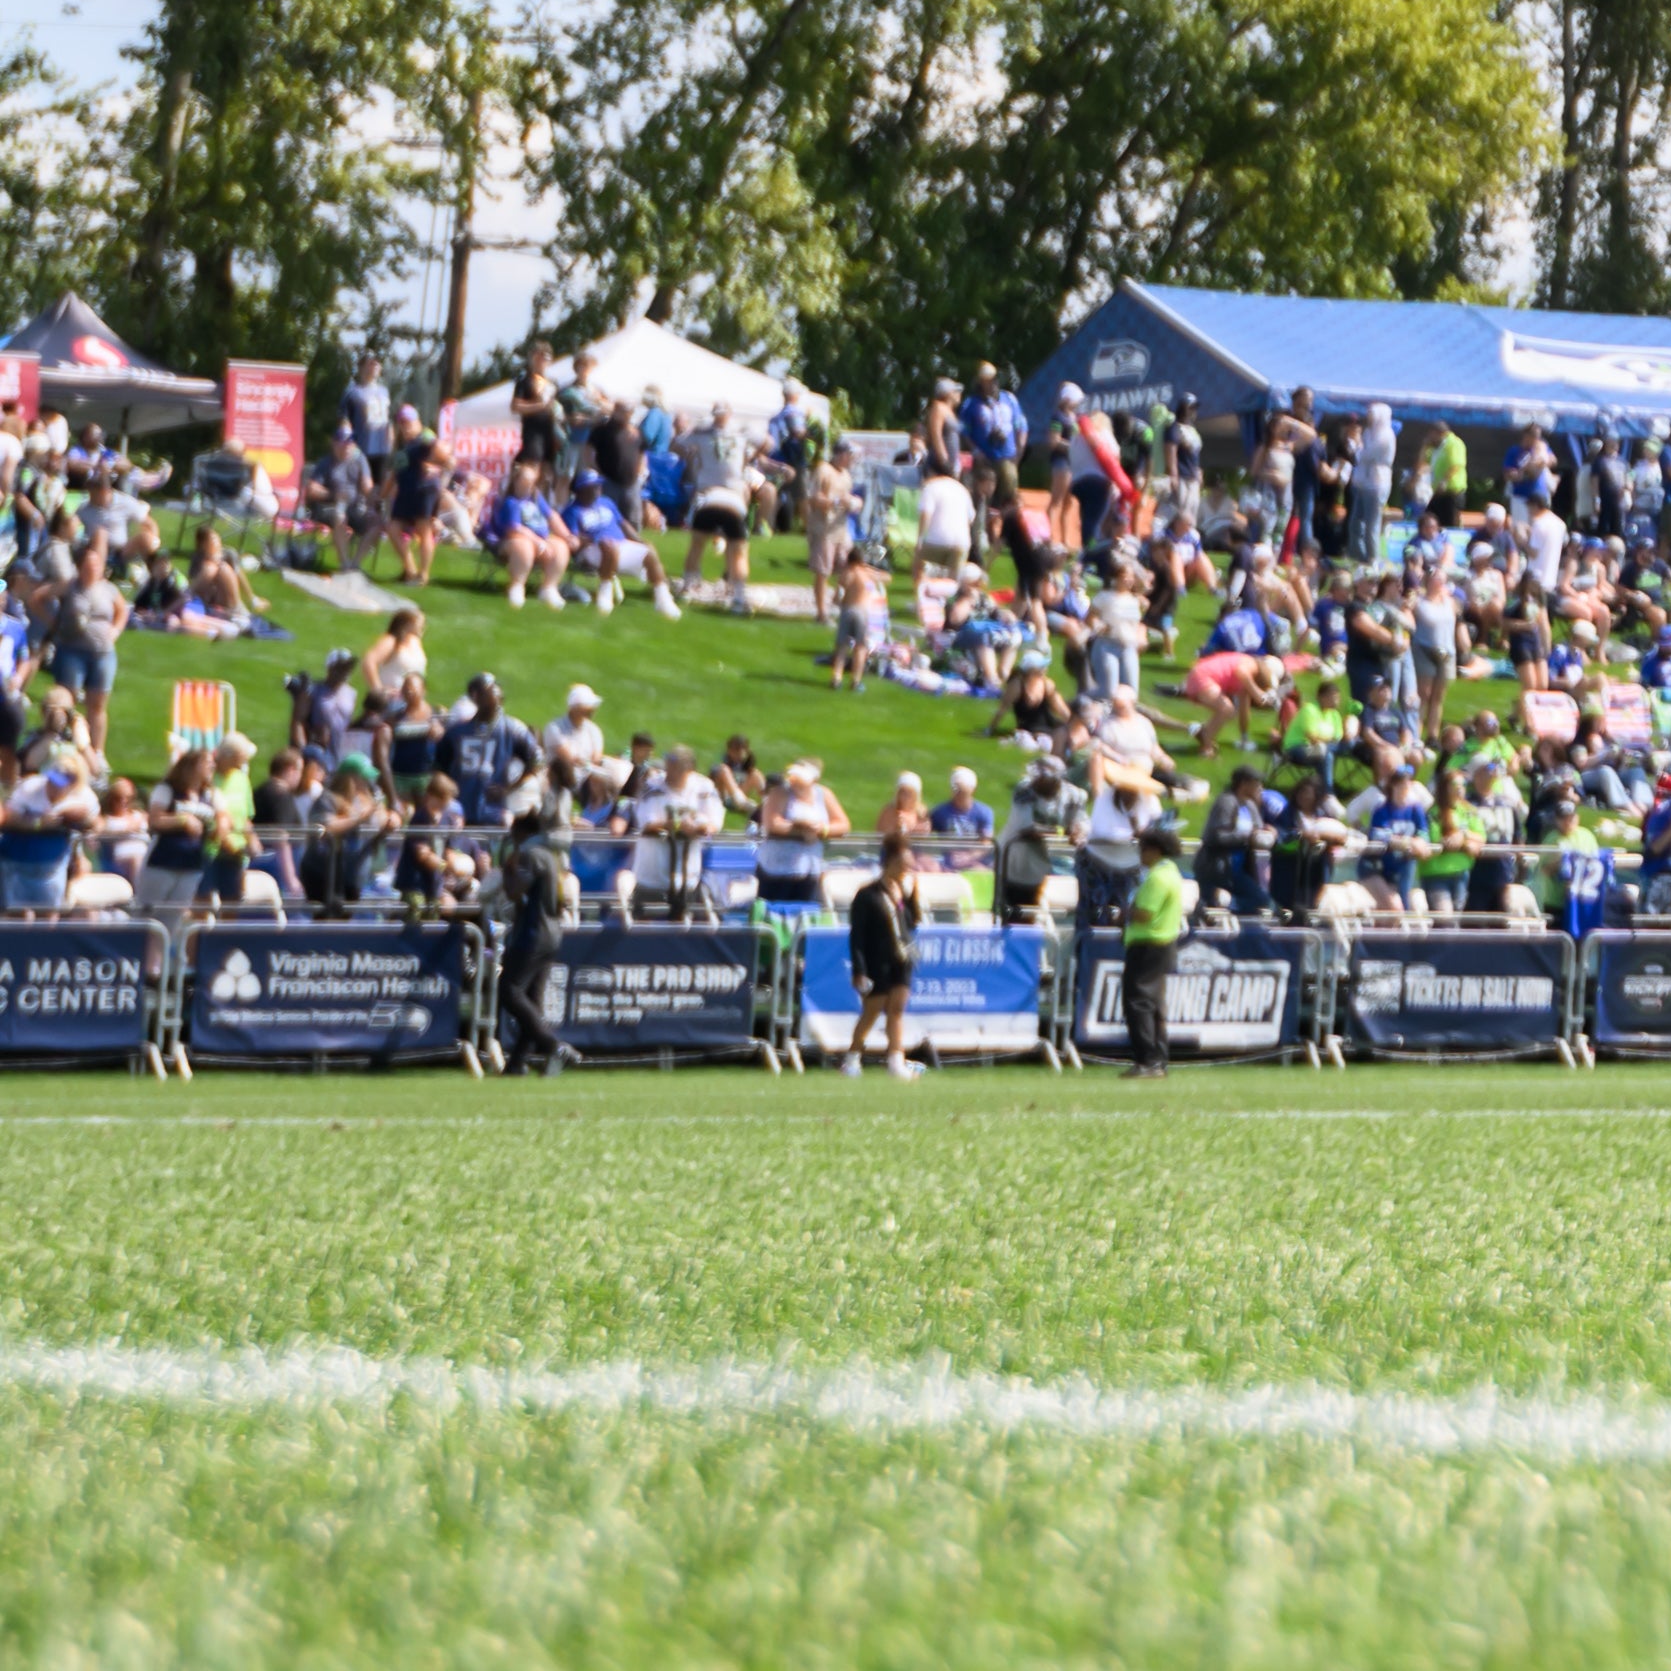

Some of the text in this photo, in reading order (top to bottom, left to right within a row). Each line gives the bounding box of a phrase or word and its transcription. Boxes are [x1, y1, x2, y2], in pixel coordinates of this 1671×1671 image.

[1078, 382, 1173, 419] EAHAWKS
[460, 737, 497, 773] 51
[28, 957, 141, 984] MASON
[269, 950, 420, 976] Virginia Mason
[268, 973, 449, 1000] Franciscan Health
[612, 965, 651, 991] THE
[653, 965, 693, 991] PRO
[17, 984, 138, 1014] CENTER
[1210, 974, 1276, 1022] CAMP
